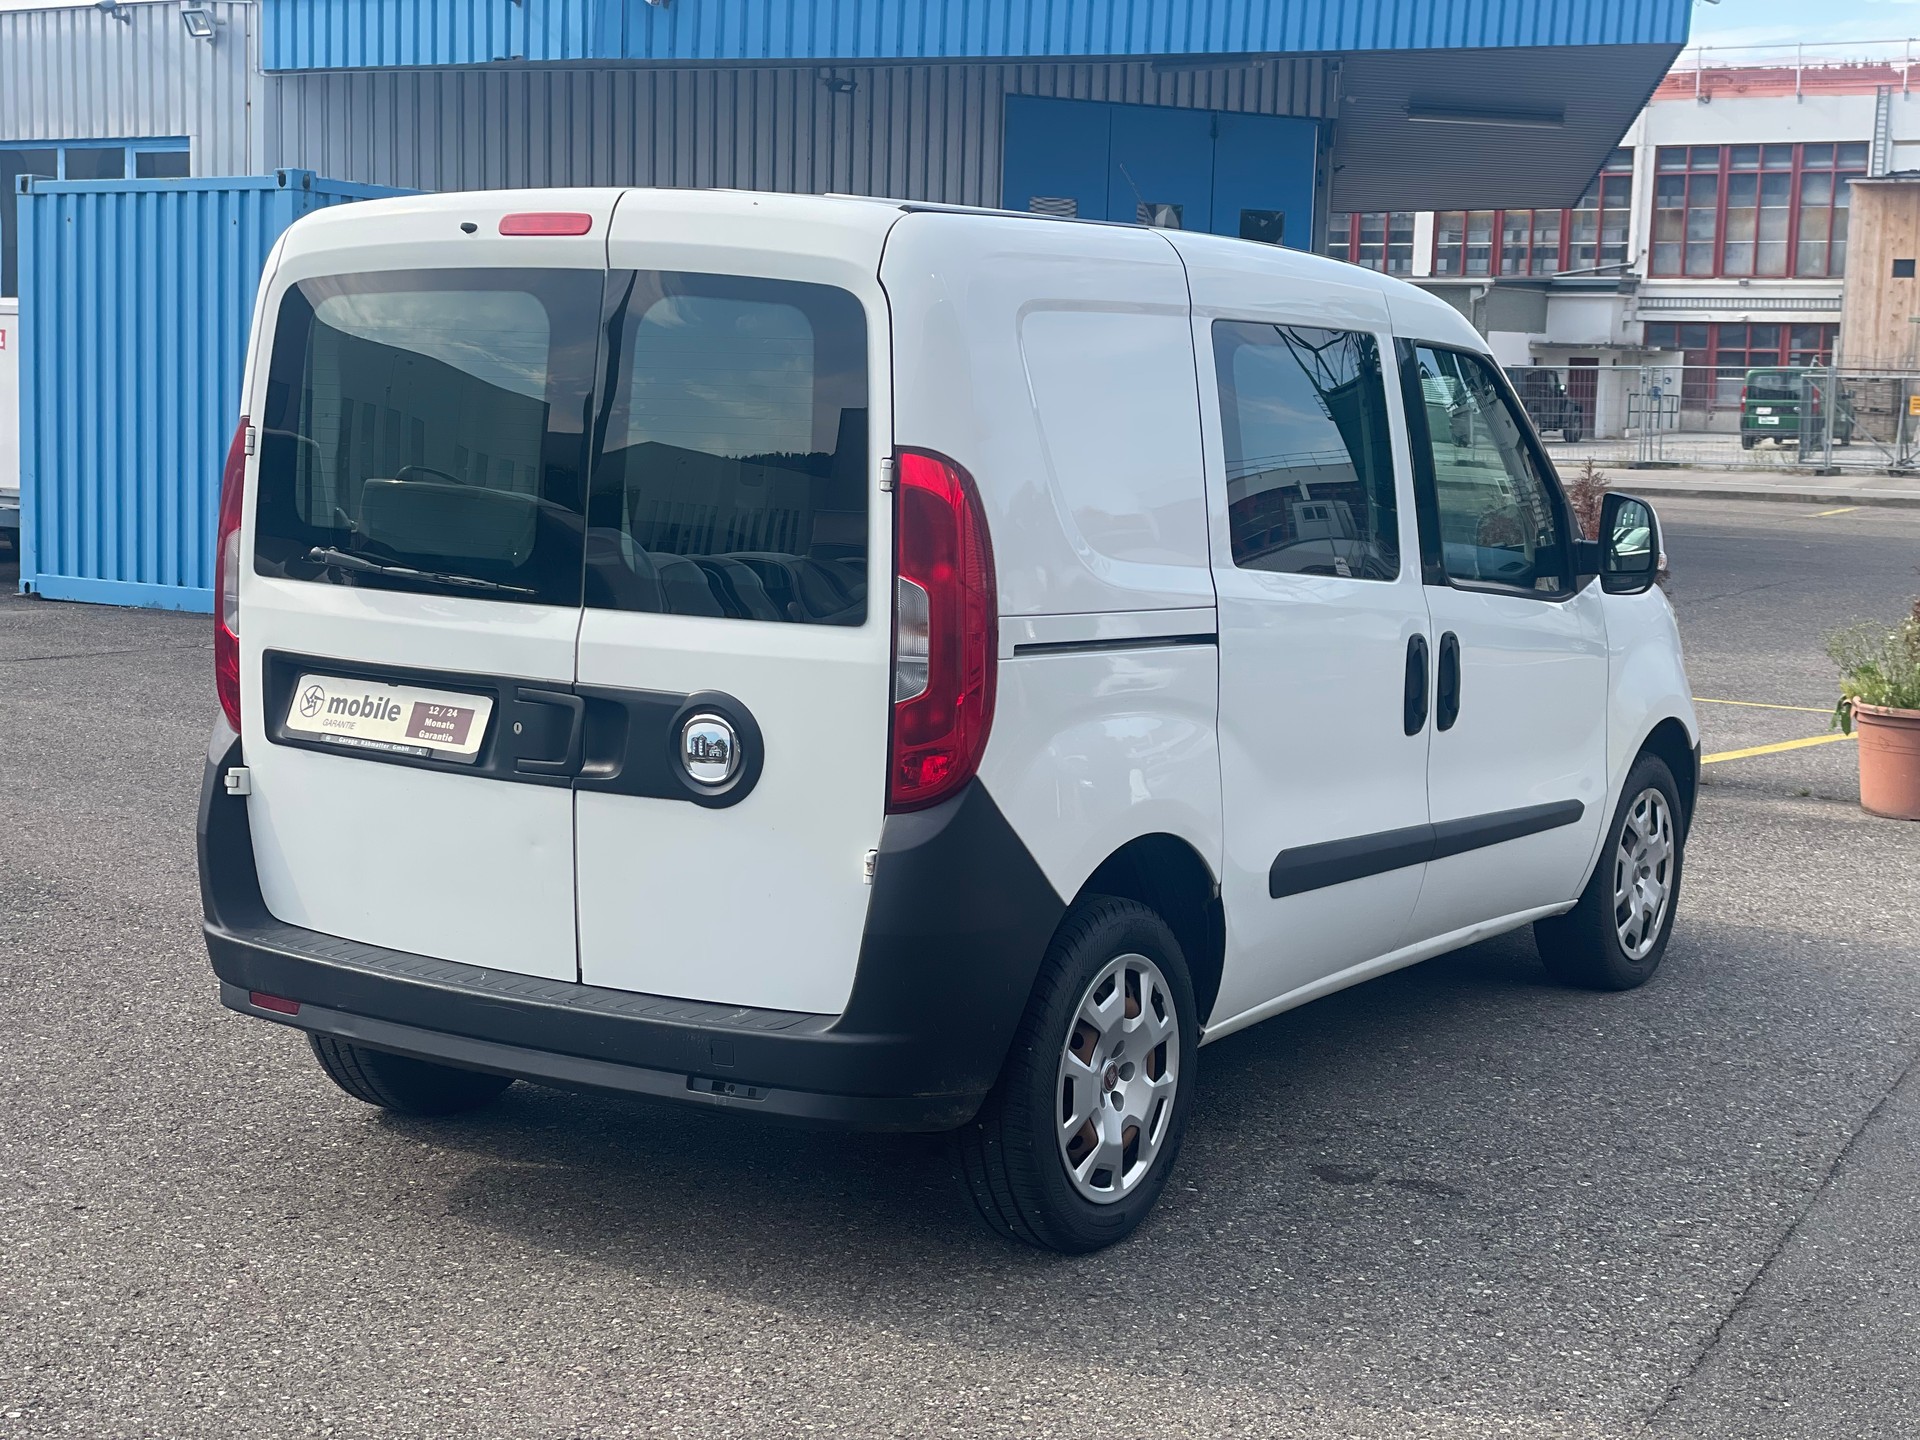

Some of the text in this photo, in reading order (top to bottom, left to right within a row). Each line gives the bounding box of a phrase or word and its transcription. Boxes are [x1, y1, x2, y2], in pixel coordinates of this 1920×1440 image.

[327, 695, 402, 722] mobile
[428, 706, 439, 715] 12
[447, 708, 458, 718] 24
[322, 718, 356, 730] GARANTIE
[424, 718, 455, 730] Monate
[418, 730, 453, 742] Garantie
[338, 737, 357, 746] Garage
[392, 744, 410, 752] GmbH
